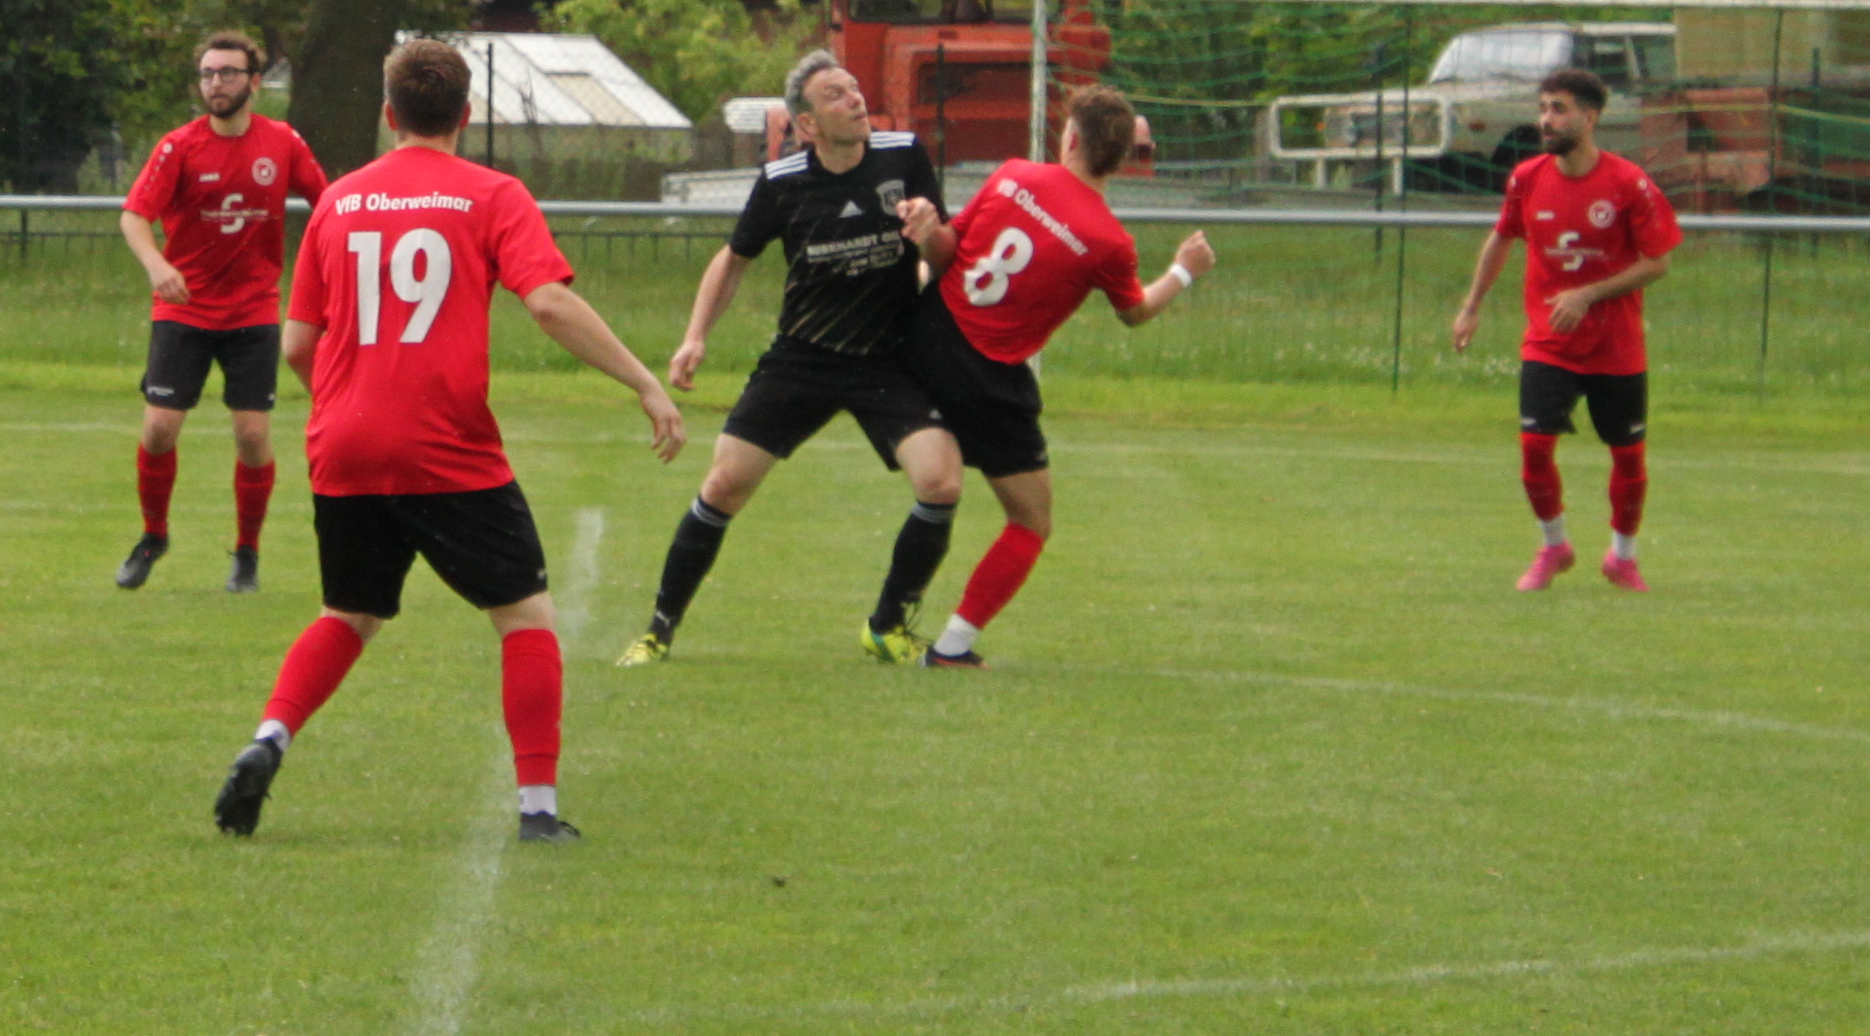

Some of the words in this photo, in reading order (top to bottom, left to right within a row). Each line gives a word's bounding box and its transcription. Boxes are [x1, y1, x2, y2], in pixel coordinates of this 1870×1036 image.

[335, 194, 362, 215] VfB
[365, 191, 473, 213] Oberweimar
[347, 227, 453, 346] 19
[962, 227, 1034, 307] 8
